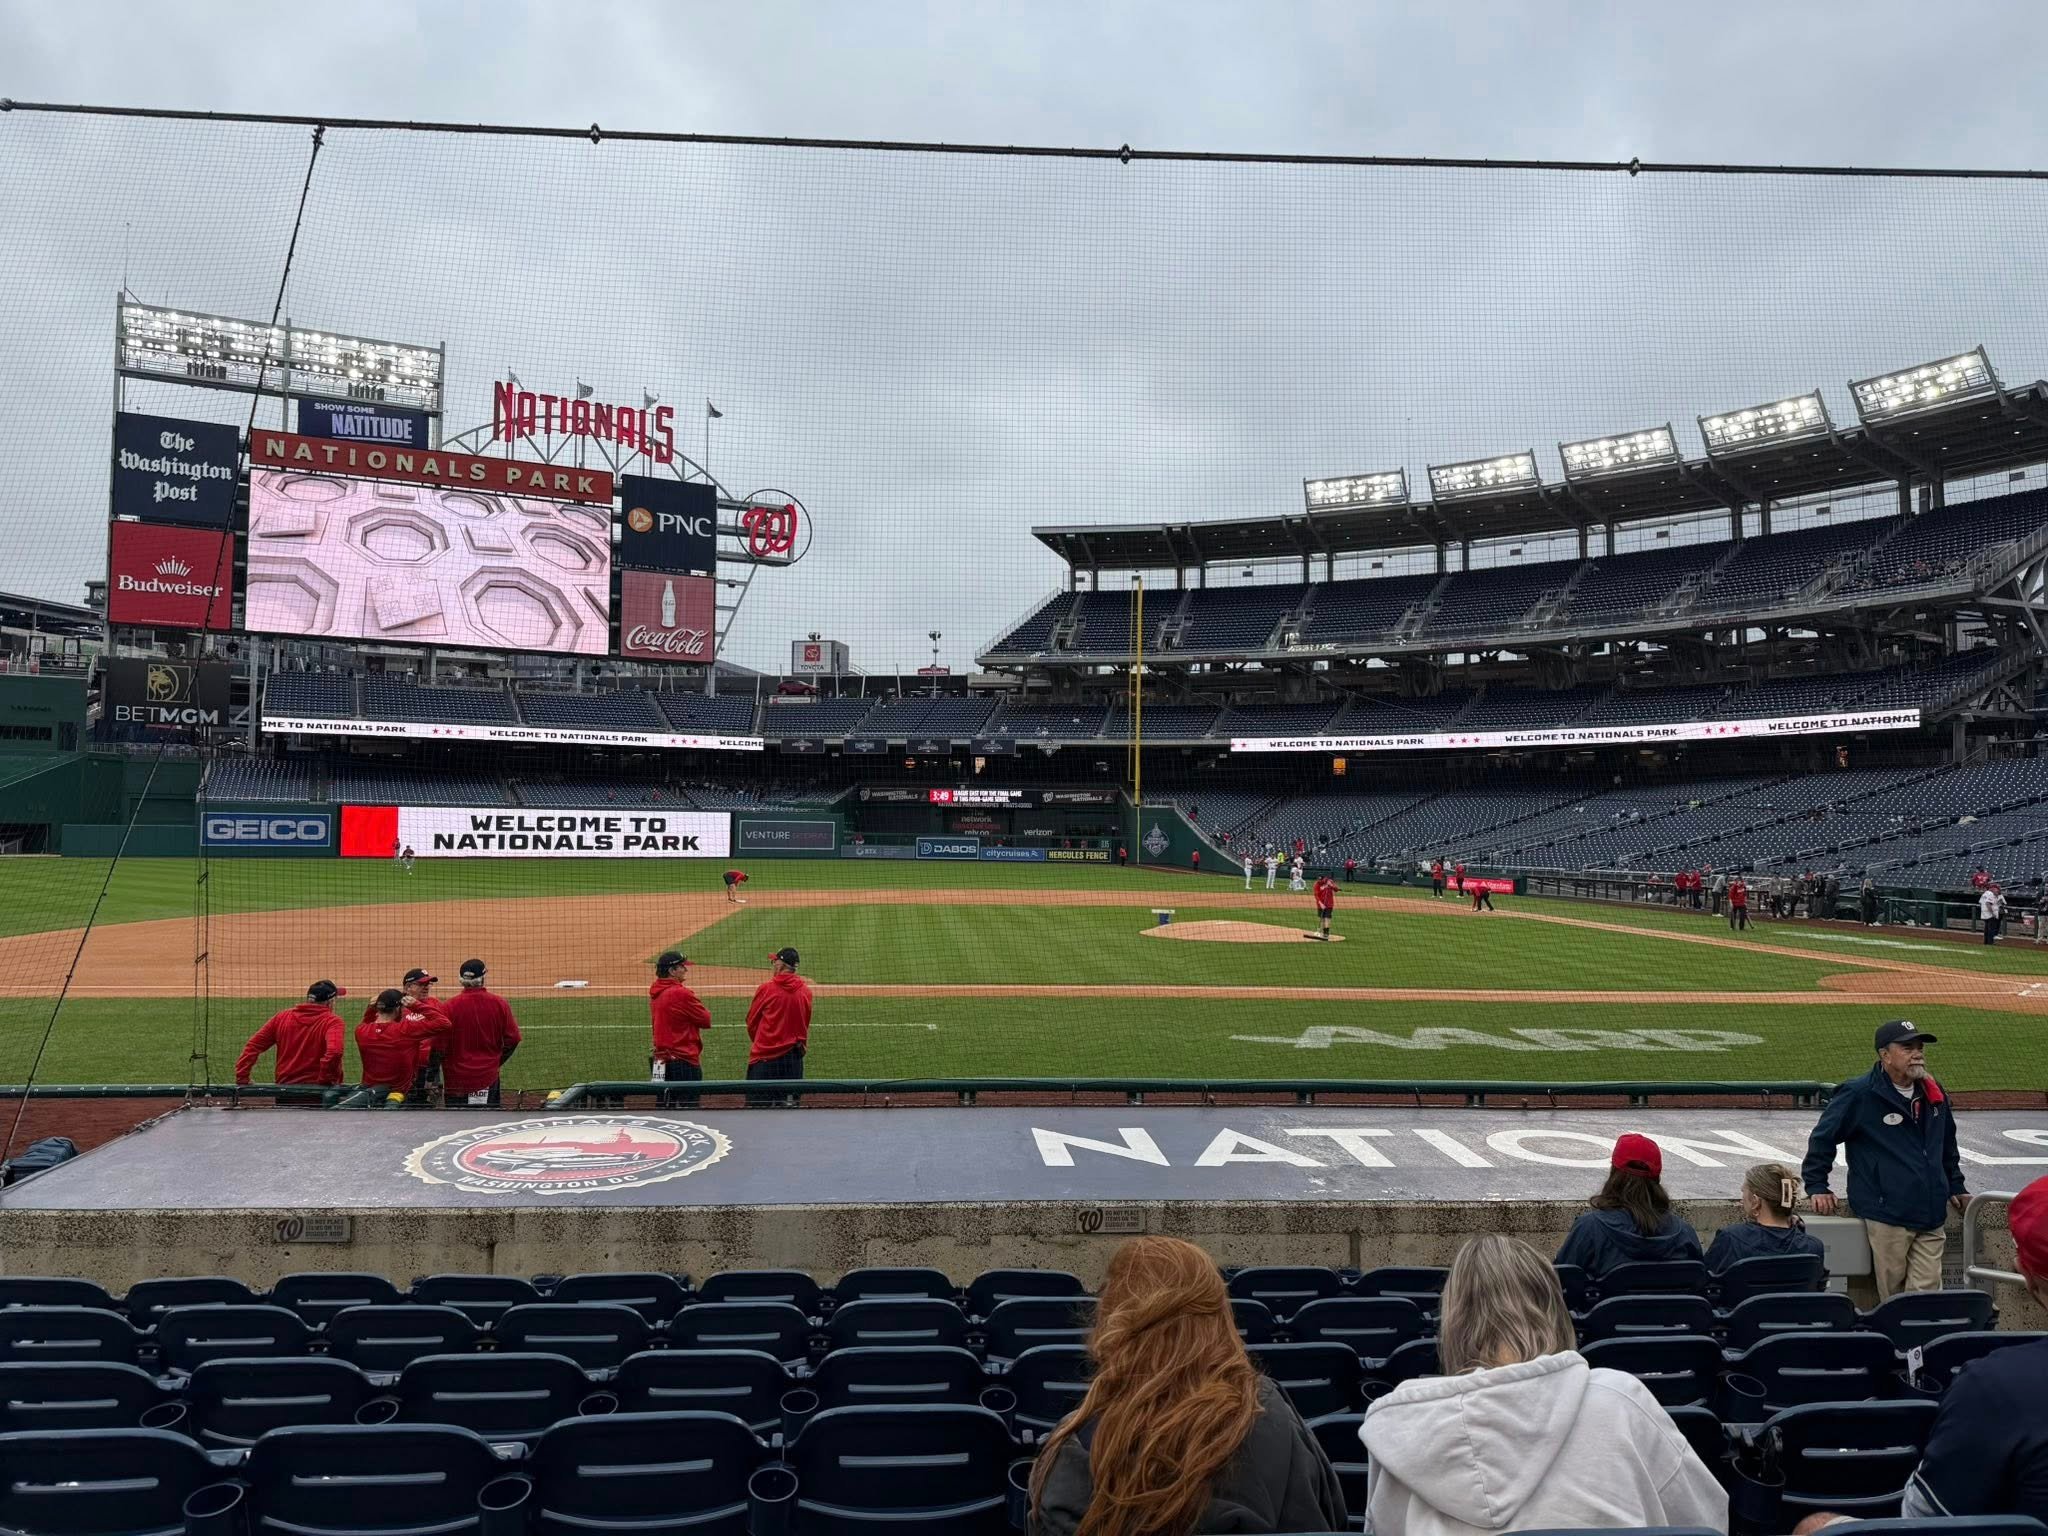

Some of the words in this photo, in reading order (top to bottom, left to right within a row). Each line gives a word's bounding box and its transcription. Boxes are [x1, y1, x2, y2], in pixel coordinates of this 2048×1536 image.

[314, 402, 344, 412] SHOW
[347, 405, 375, 414] SOME
[331, 414, 412, 440] NATITUDE
[493, 381, 673, 464] NATIONALS
[160, 431, 195, 453] The
[119, 448, 233, 481] Washington
[266, 439, 486, 481] NATIONALS
[507, 467, 594, 494] PARK
[153, 481, 198, 503] Post
[657, 512, 712, 538] PNC
[118, 574, 224, 598] Budweiser
[625, 625, 709, 656] Coca-Cola
[115, 705, 219, 725] BETMGM
[288, 721, 303, 729] TO
[306, 722, 373, 732] NATIONALS
[376, 725, 407, 733] PARK
[1768, 719, 1828, 731] WELCOME
[1830, 718, 1848, 727] TO
[489, 730, 542, 738] WELCOME
[560, 732, 619, 742] NATIONALS
[621, 735, 649, 743] PARK
[1270, 740, 1317, 748] WELCOME
[1335, 738, 1394, 747] NATIONALS
[1505, 733, 1558, 742] WELCOME
[1578, 730, 1644, 740] NATIONALS
[1647, 728, 1678, 737] PARK
[207, 819, 326, 840] GEICO
[470, 815, 622, 833] WELCOME
[629, 817, 667, 833] TO
[1023, 828, 1053, 836] verizon
[433, 833, 614, 851] NATIONALS
[623, 835, 700, 851] PARK
[746, 831, 791, 840] VENTURE
[933, 845, 977, 854] DABOS
[986, 849, 1030, 859] citycruises
[1048, 850, 1084, 860] HERCULES
[1085, 851, 1109, 860] FENCE
[448, 1119, 649, 1146] NATIONALS
[657, 1123, 711, 1147] PARK
[456, 1174, 601, 1189] WASHINGTON
[609, 1174, 640, 1185] DC
